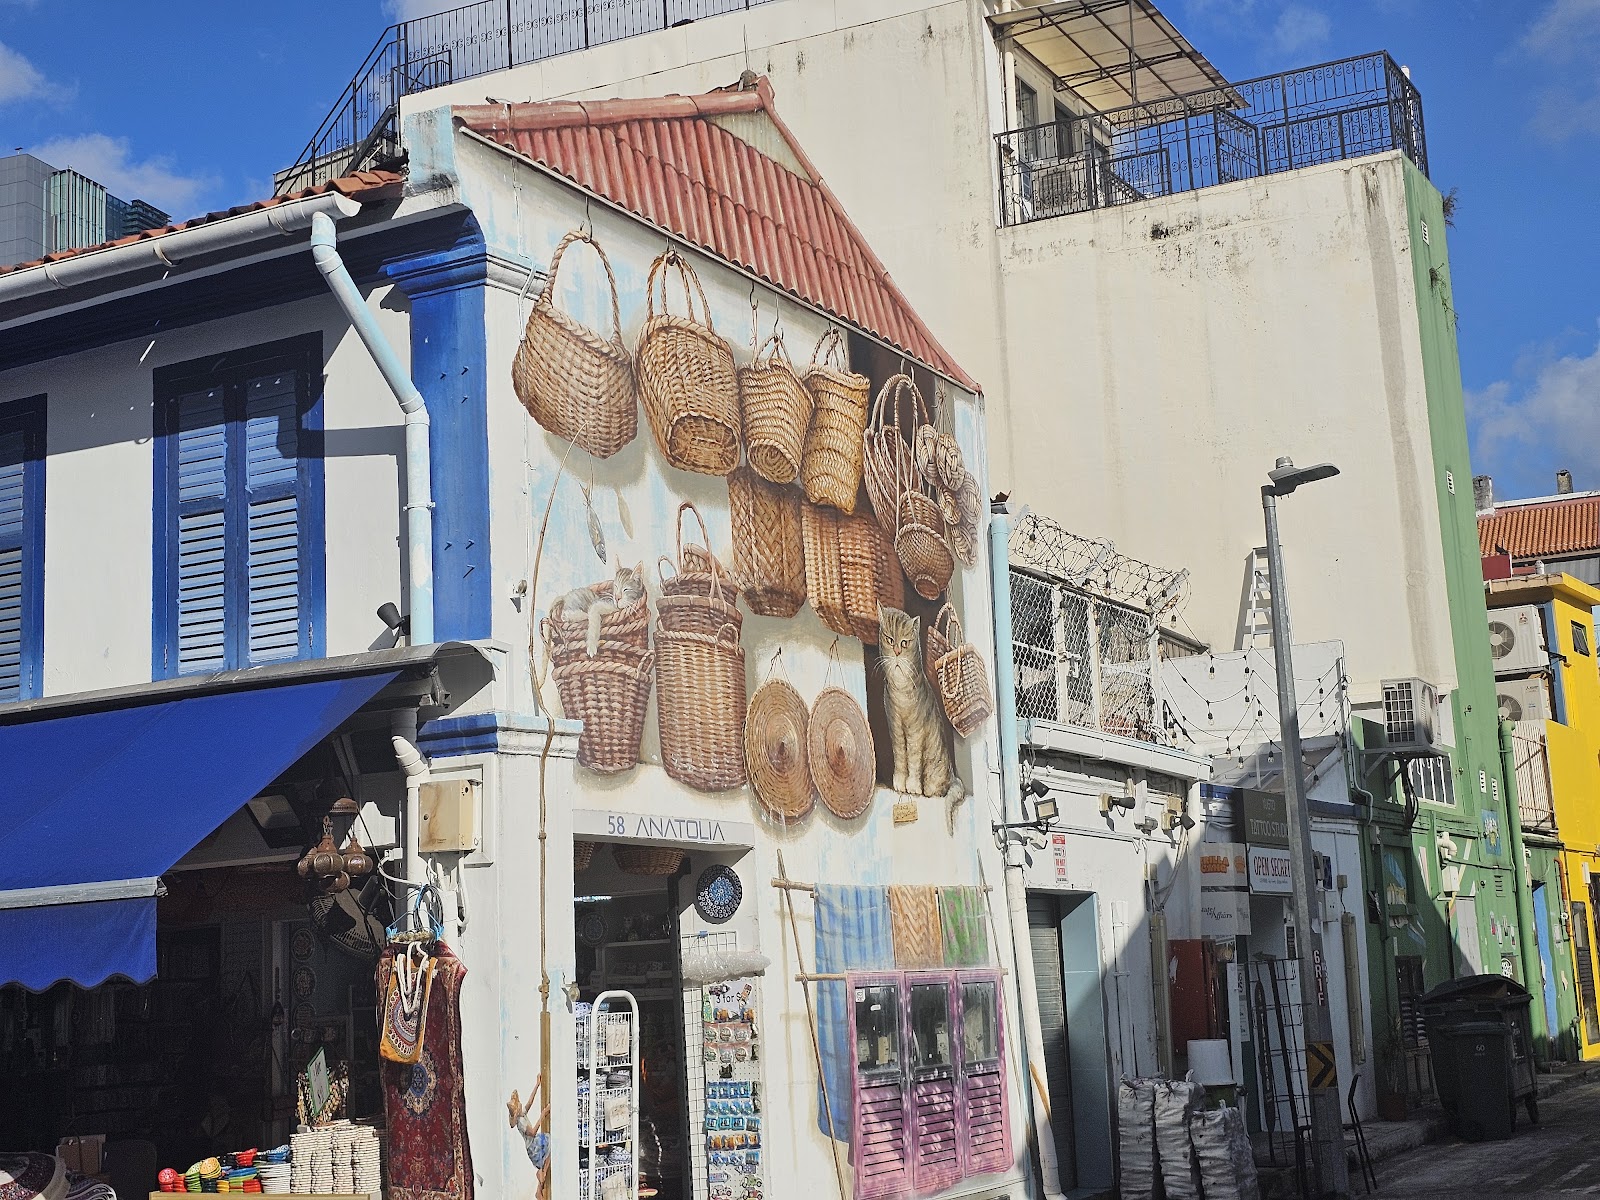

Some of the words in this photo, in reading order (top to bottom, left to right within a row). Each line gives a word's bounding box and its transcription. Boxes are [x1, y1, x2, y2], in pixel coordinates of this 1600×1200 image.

[608, 815, 625, 835] 58
[636, 816, 725, 841] ANATOLIA
[1250, 818, 1271, 836] TATTOO
[1271, 821, 1289, 838] STUDI
[1253, 856, 1270, 876] OPEN
[1211, 908, 1233, 921] Affairs
[716, 995, 721, 1004] 3
[723, 994, 735, 1004] for
